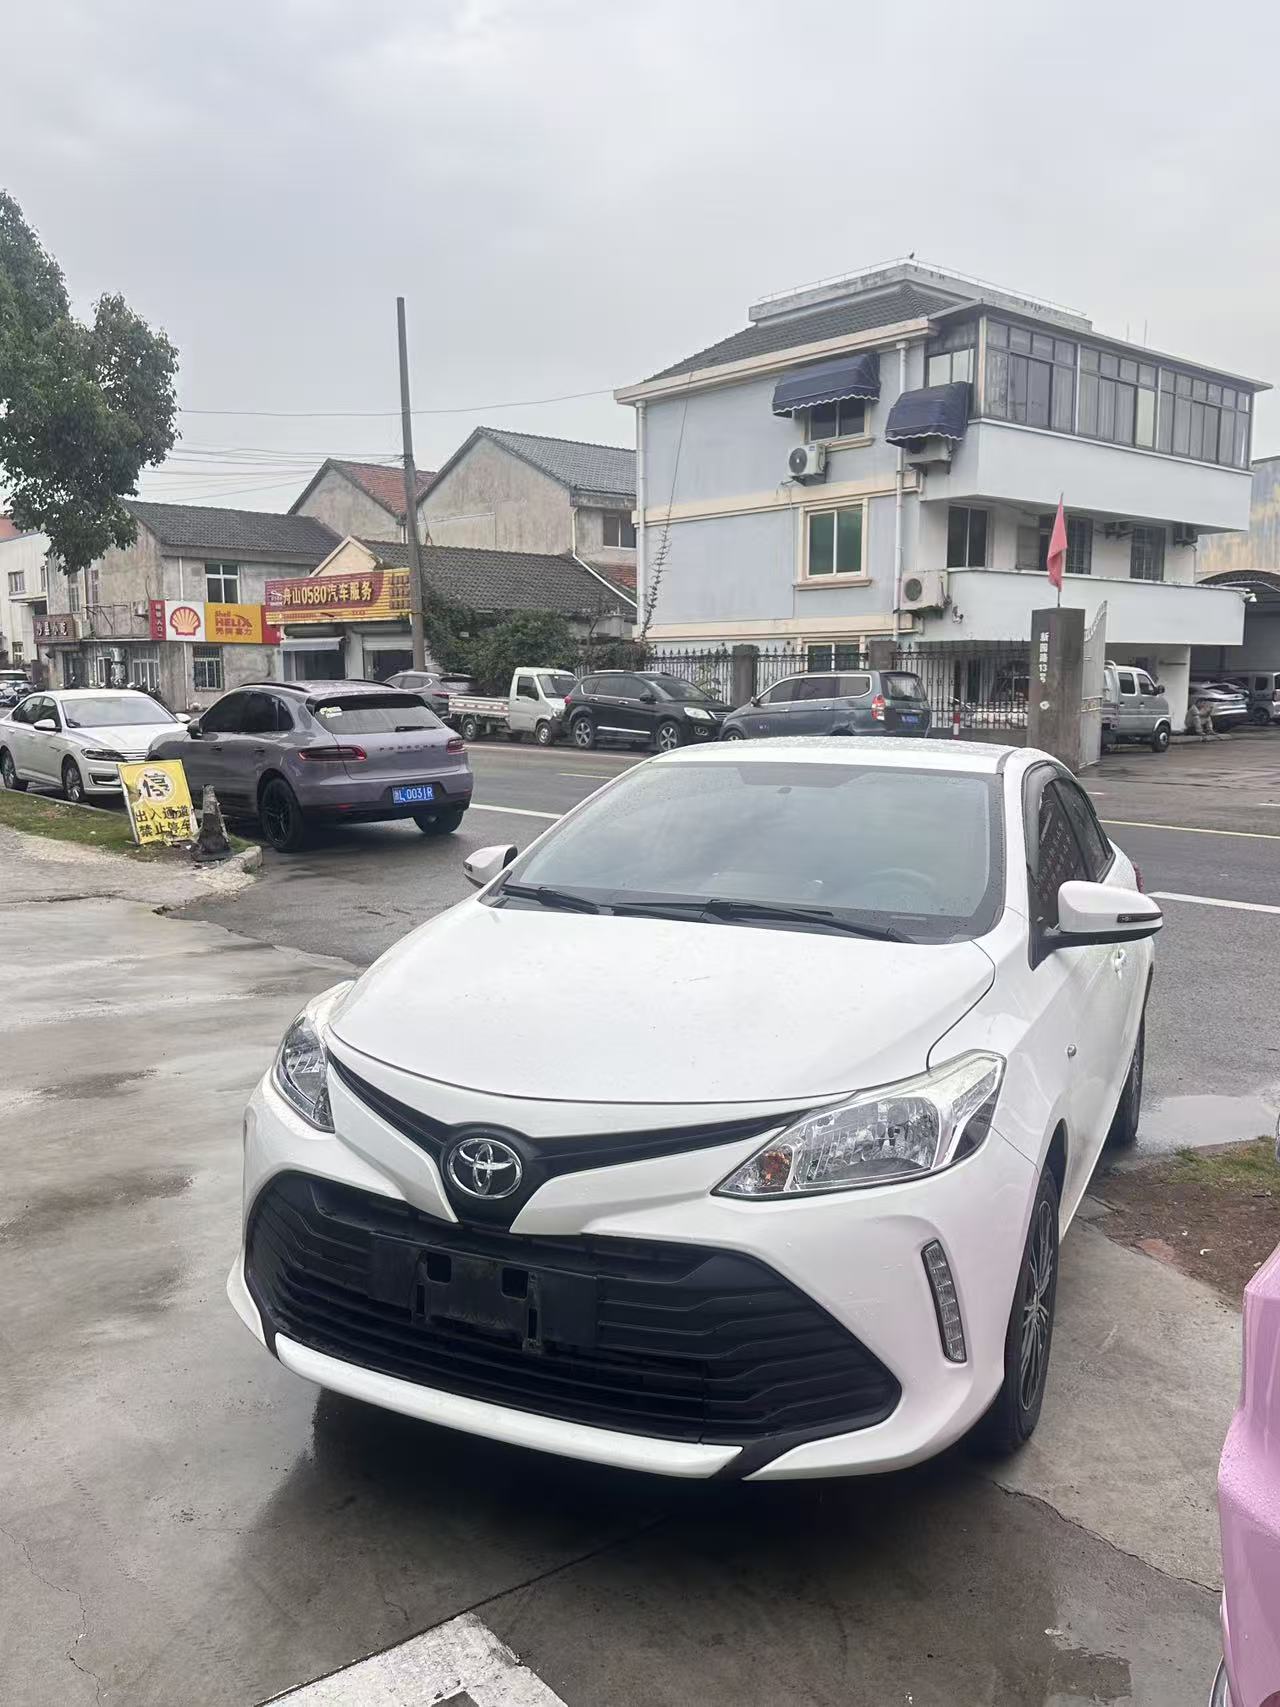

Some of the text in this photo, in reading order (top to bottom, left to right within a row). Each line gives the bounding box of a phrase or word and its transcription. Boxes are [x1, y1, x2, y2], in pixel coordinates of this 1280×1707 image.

[283, 580, 373, 605] 舟山0580汽车服务
[215, 617, 252, 627] HELIX
[135, 805, 190, 822] 出入通道
[139, 819, 191, 838] 禁止停车
